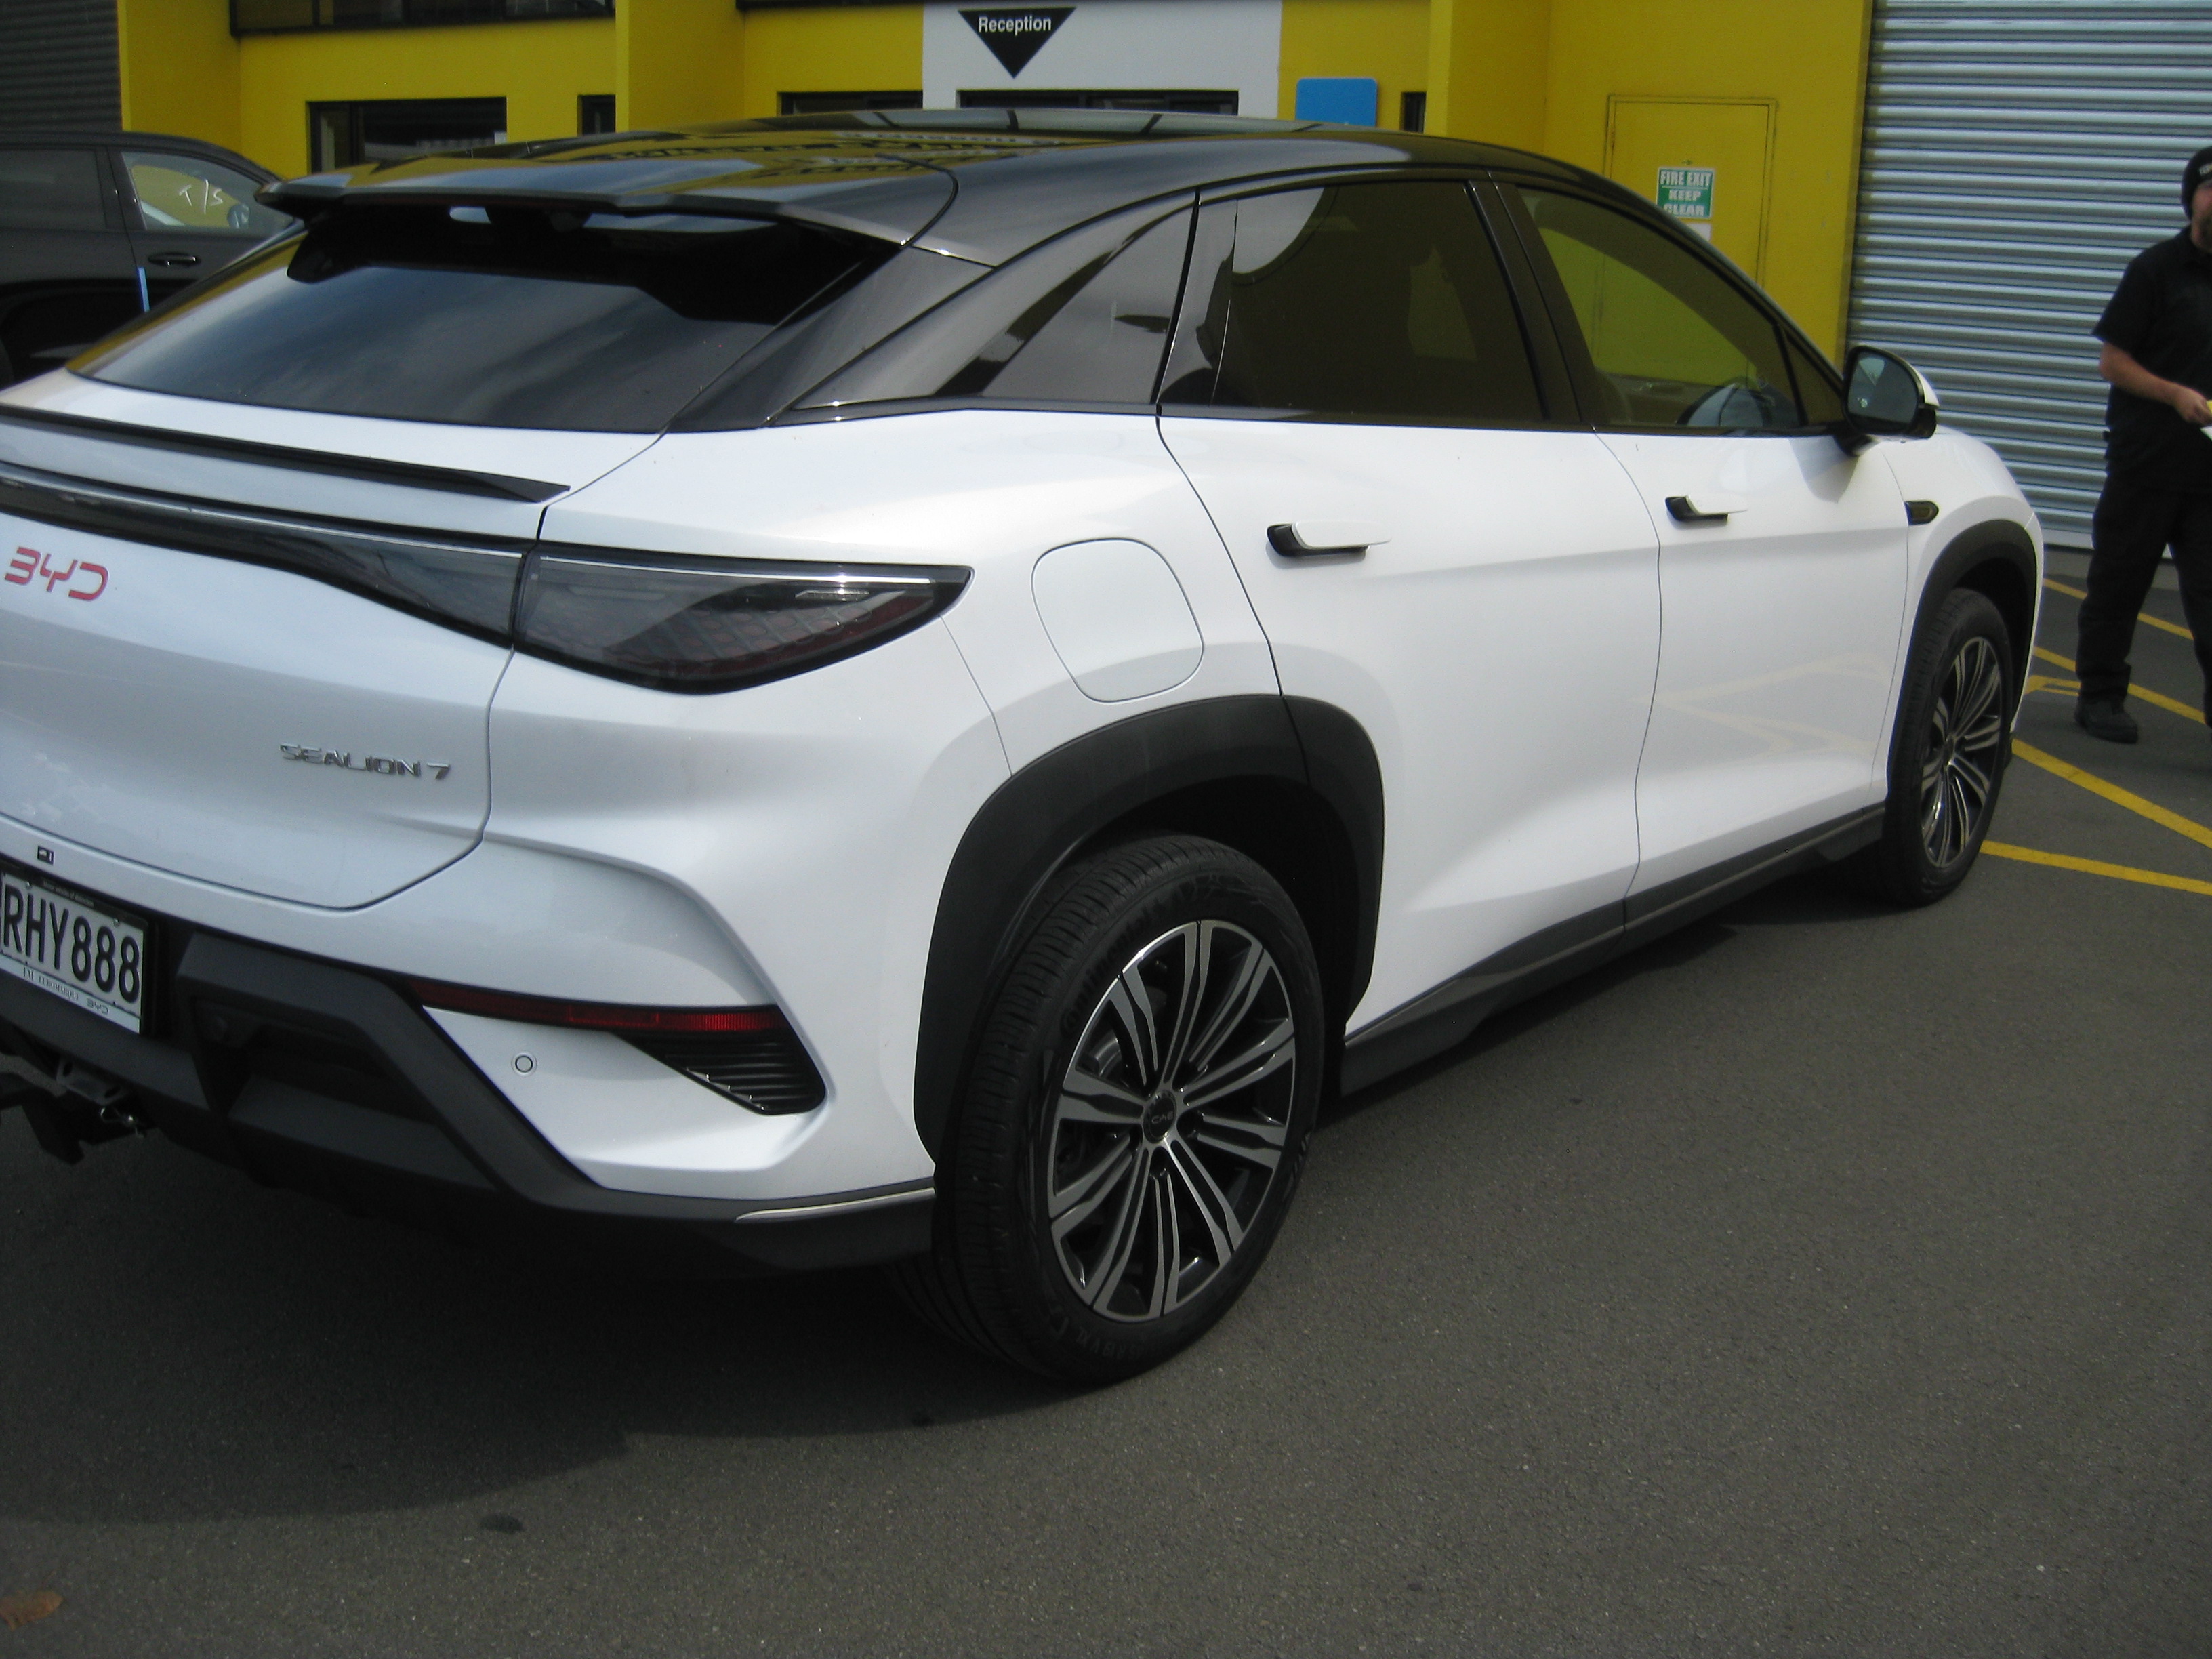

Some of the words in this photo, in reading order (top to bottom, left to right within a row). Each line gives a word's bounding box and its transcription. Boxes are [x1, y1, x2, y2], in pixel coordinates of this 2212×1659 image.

[978, 15, 1052, 36] Reception
[1660, 171, 1684, 185] FIRE
[1687, 172, 1711, 186] EXIT
[1669, 190, 1701, 201] KEEP
[1664, 204, 1704, 216] CLEAR
[5, 546, 109, 601] BYD
[279, 742, 422, 777] SEALION
[426, 762, 451, 780] 7
[3, 884, 140, 1004] RHY888
[86, 997, 110, 1015] BYD
